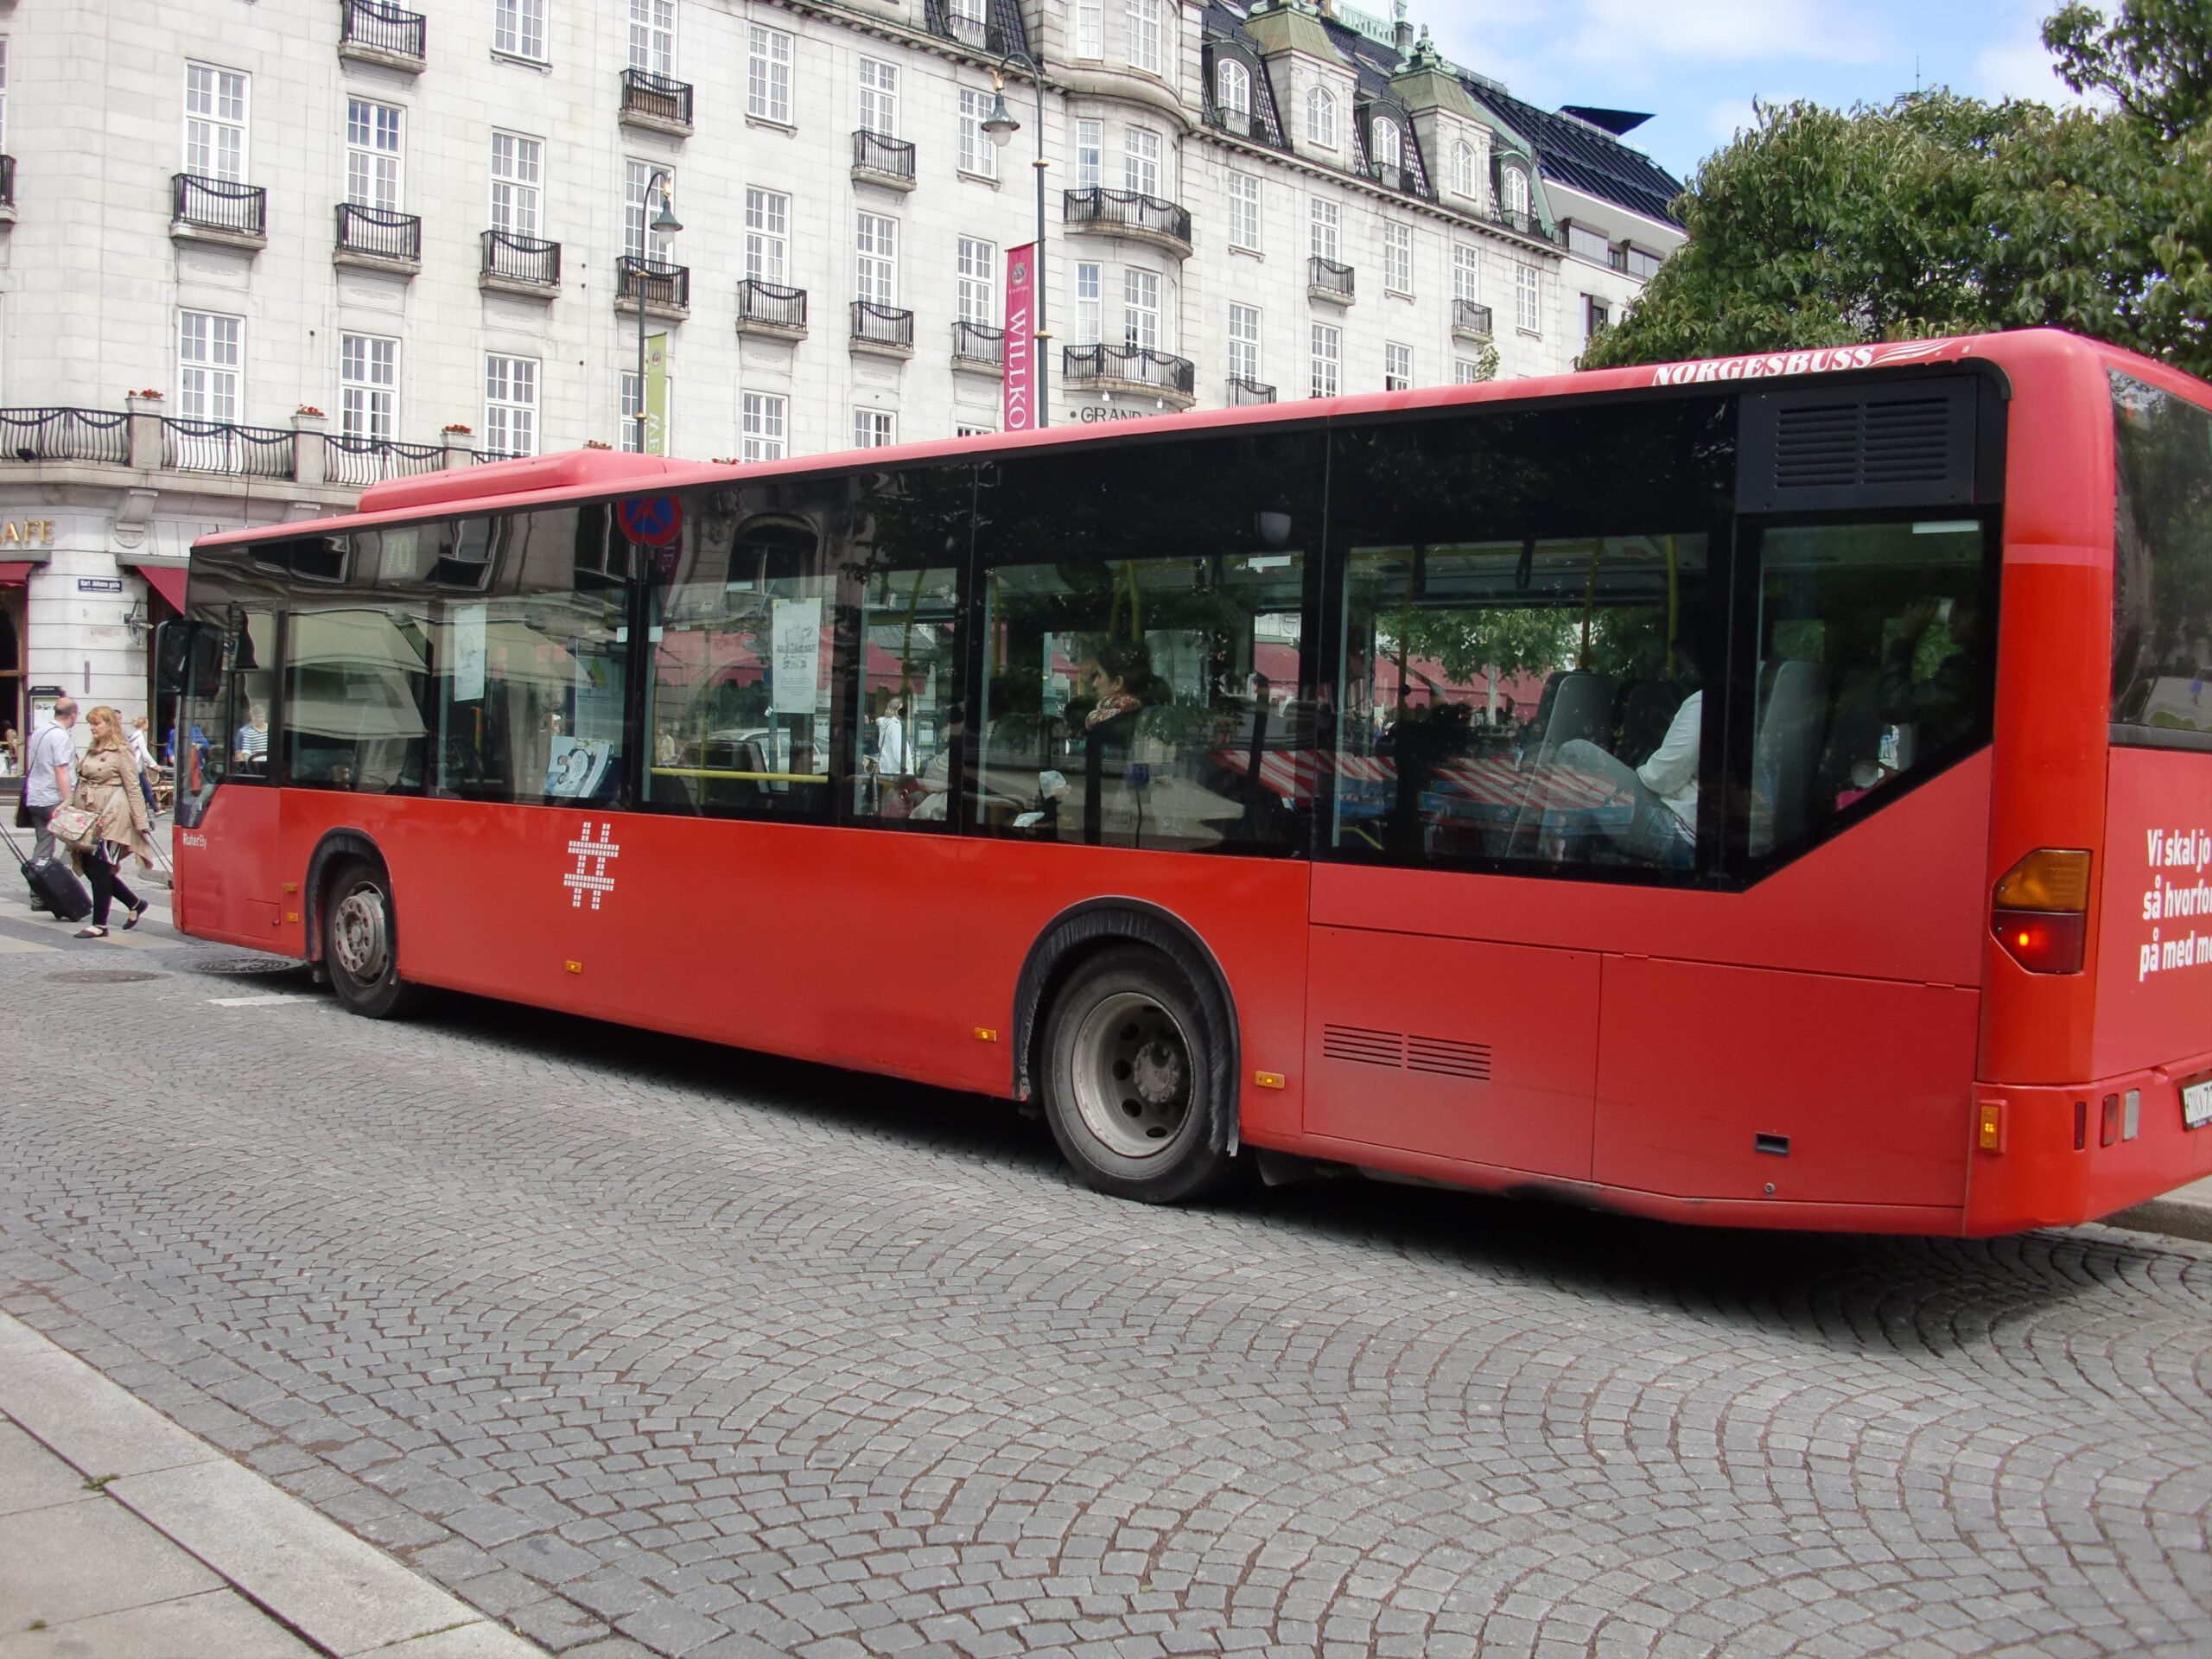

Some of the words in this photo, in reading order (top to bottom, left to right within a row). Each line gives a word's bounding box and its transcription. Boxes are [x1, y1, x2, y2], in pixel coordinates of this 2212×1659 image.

[1651, 347, 1875, 386] NORGESBUSS
[649, 413, 660, 453] WE
[0, 520, 56, 543] AFE
[2147, 829, 2163, 867] Vi
[2164, 829, 2196, 867] skal
[2196, 830, 2211, 873] jo
[2143, 874, 2161, 920] så
[2139, 926, 2159, 982] på
[2162, 930, 2195, 970] med
